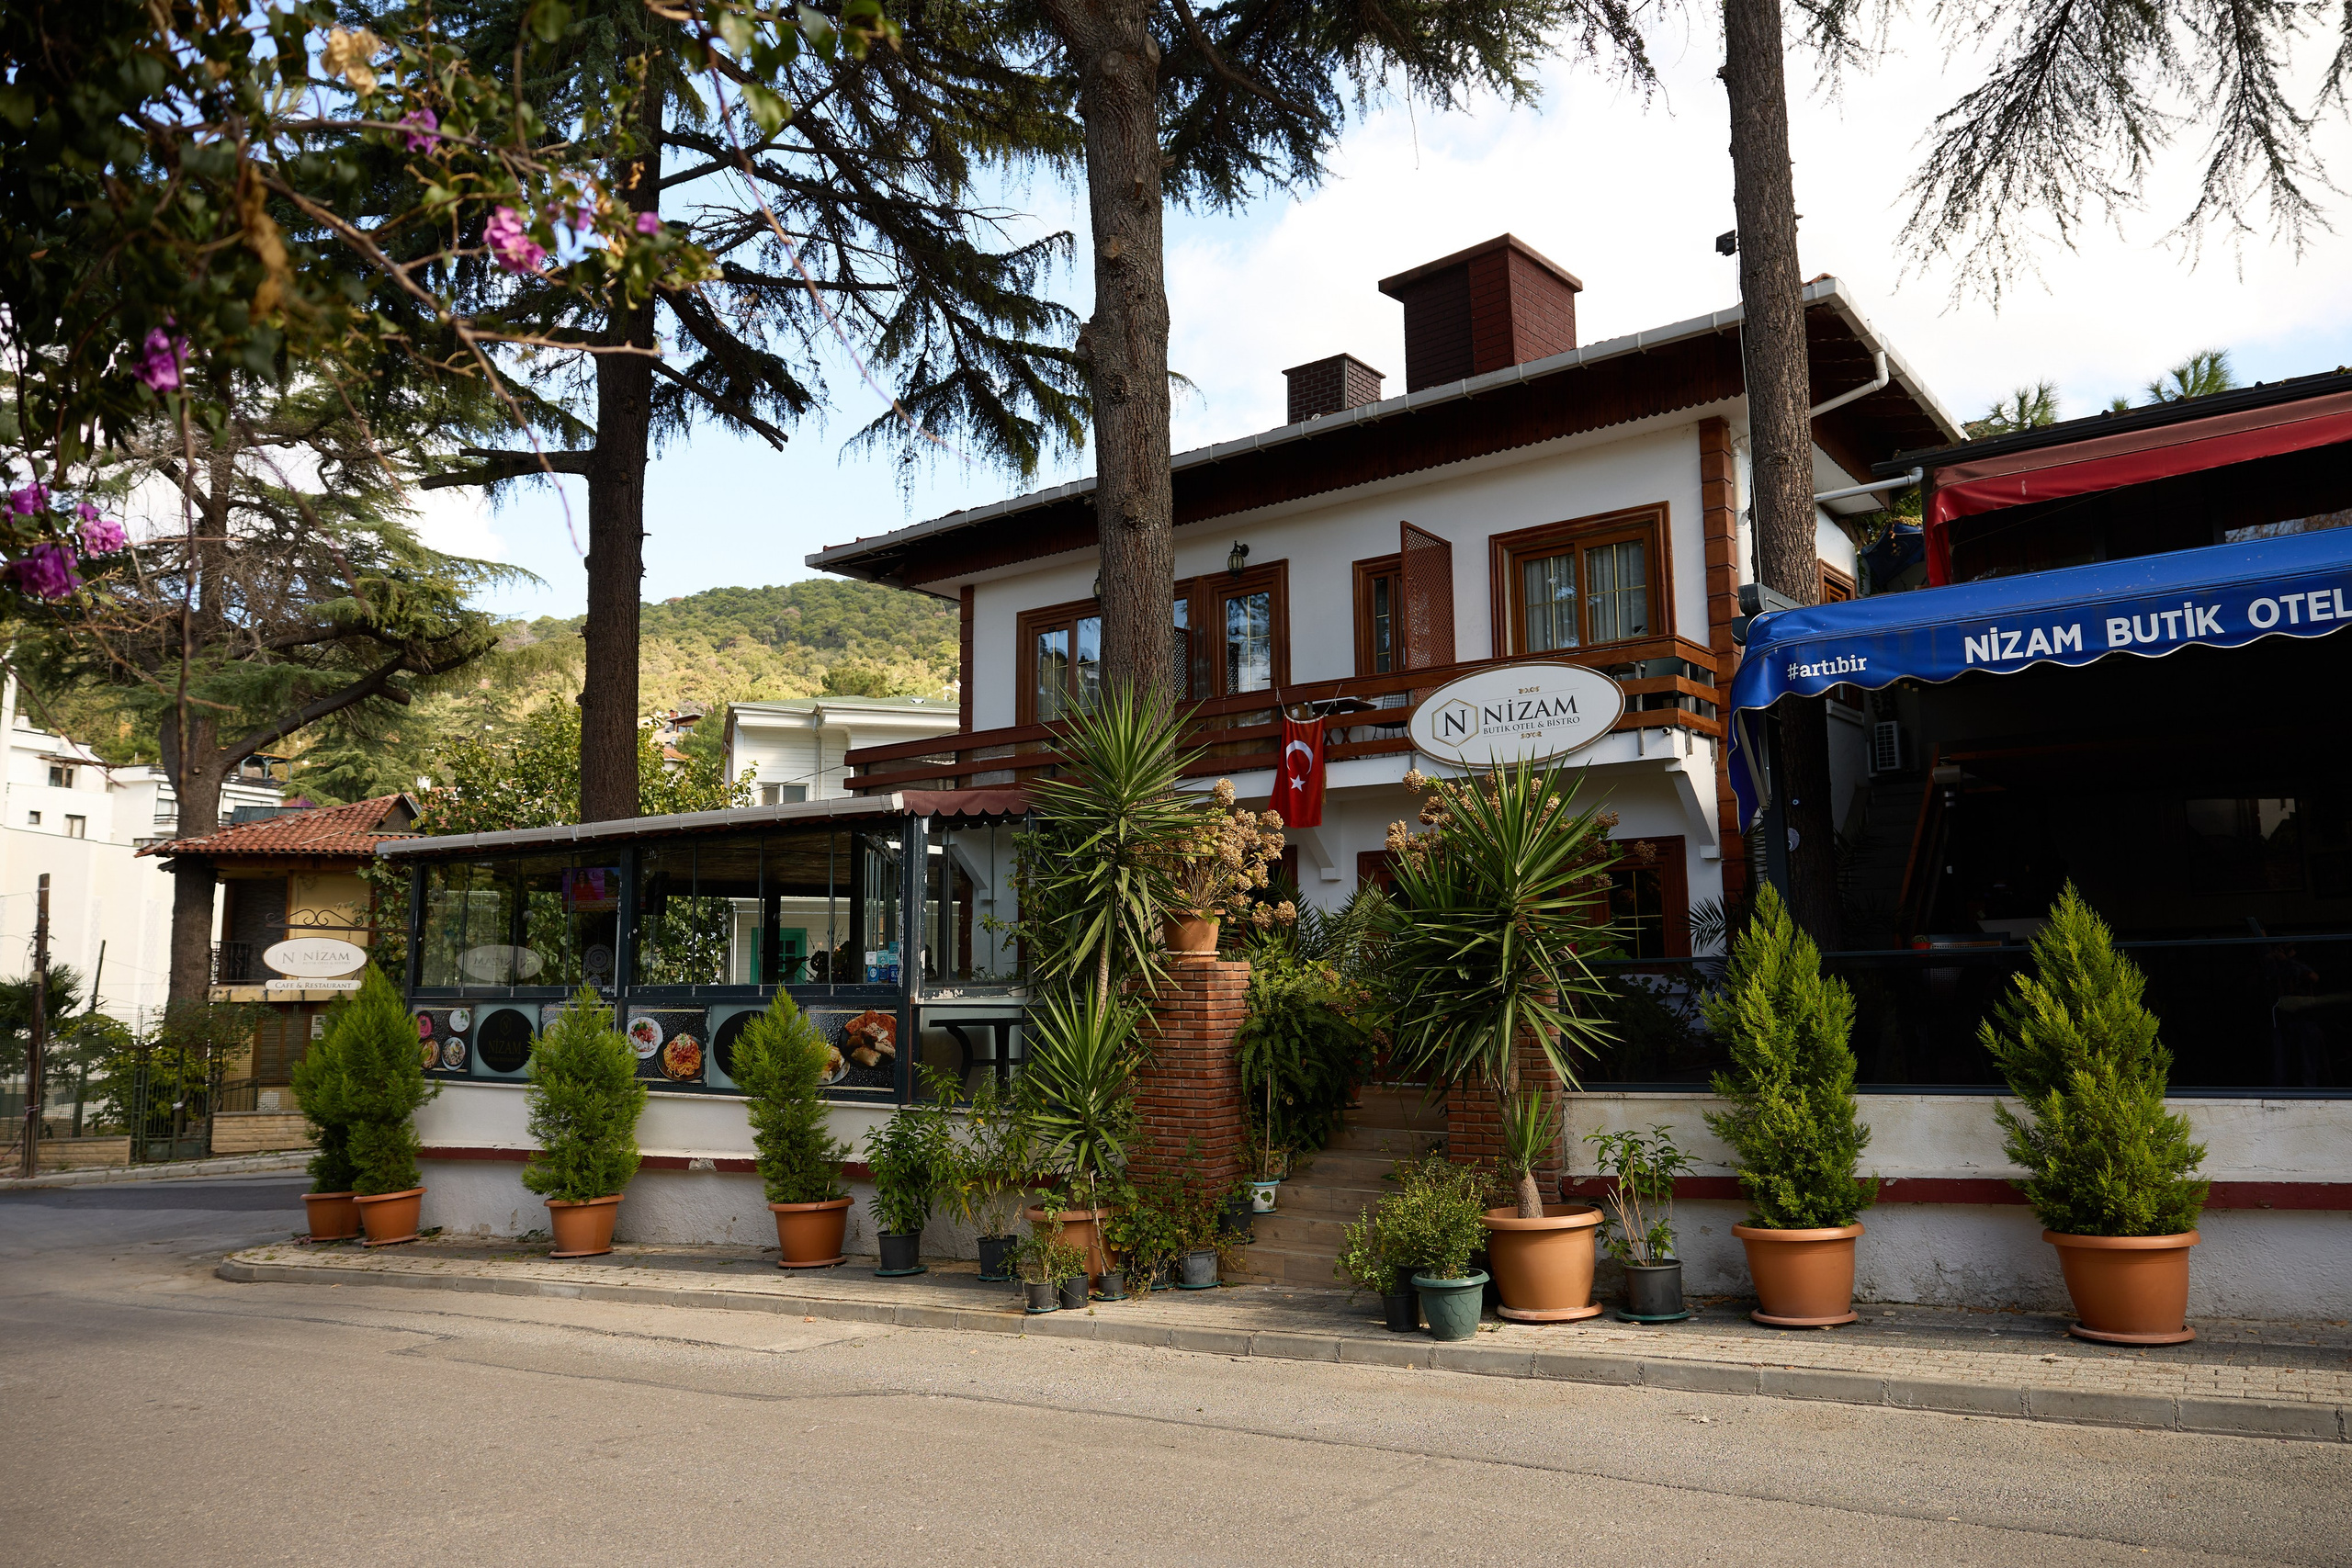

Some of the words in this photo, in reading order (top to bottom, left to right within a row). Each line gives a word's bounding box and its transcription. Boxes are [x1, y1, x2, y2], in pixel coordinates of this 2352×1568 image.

[1964, 626, 2083, 664] NİZAM
[2106, 602, 2225, 648] BUTİK
[2247, 588, 2352, 629] OTEL
[1483, 694, 1579, 725] NİZAM
[1443, 709, 1467, 737] N
[1483, 724, 1511, 735] BUTİK
[1547, 716, 1580, 727] BİSTRO
[281, 952, 295, 964] N
[303, 950, 350, 961] NİZAM
[487, 1038, 522, 1055] NİZAM
